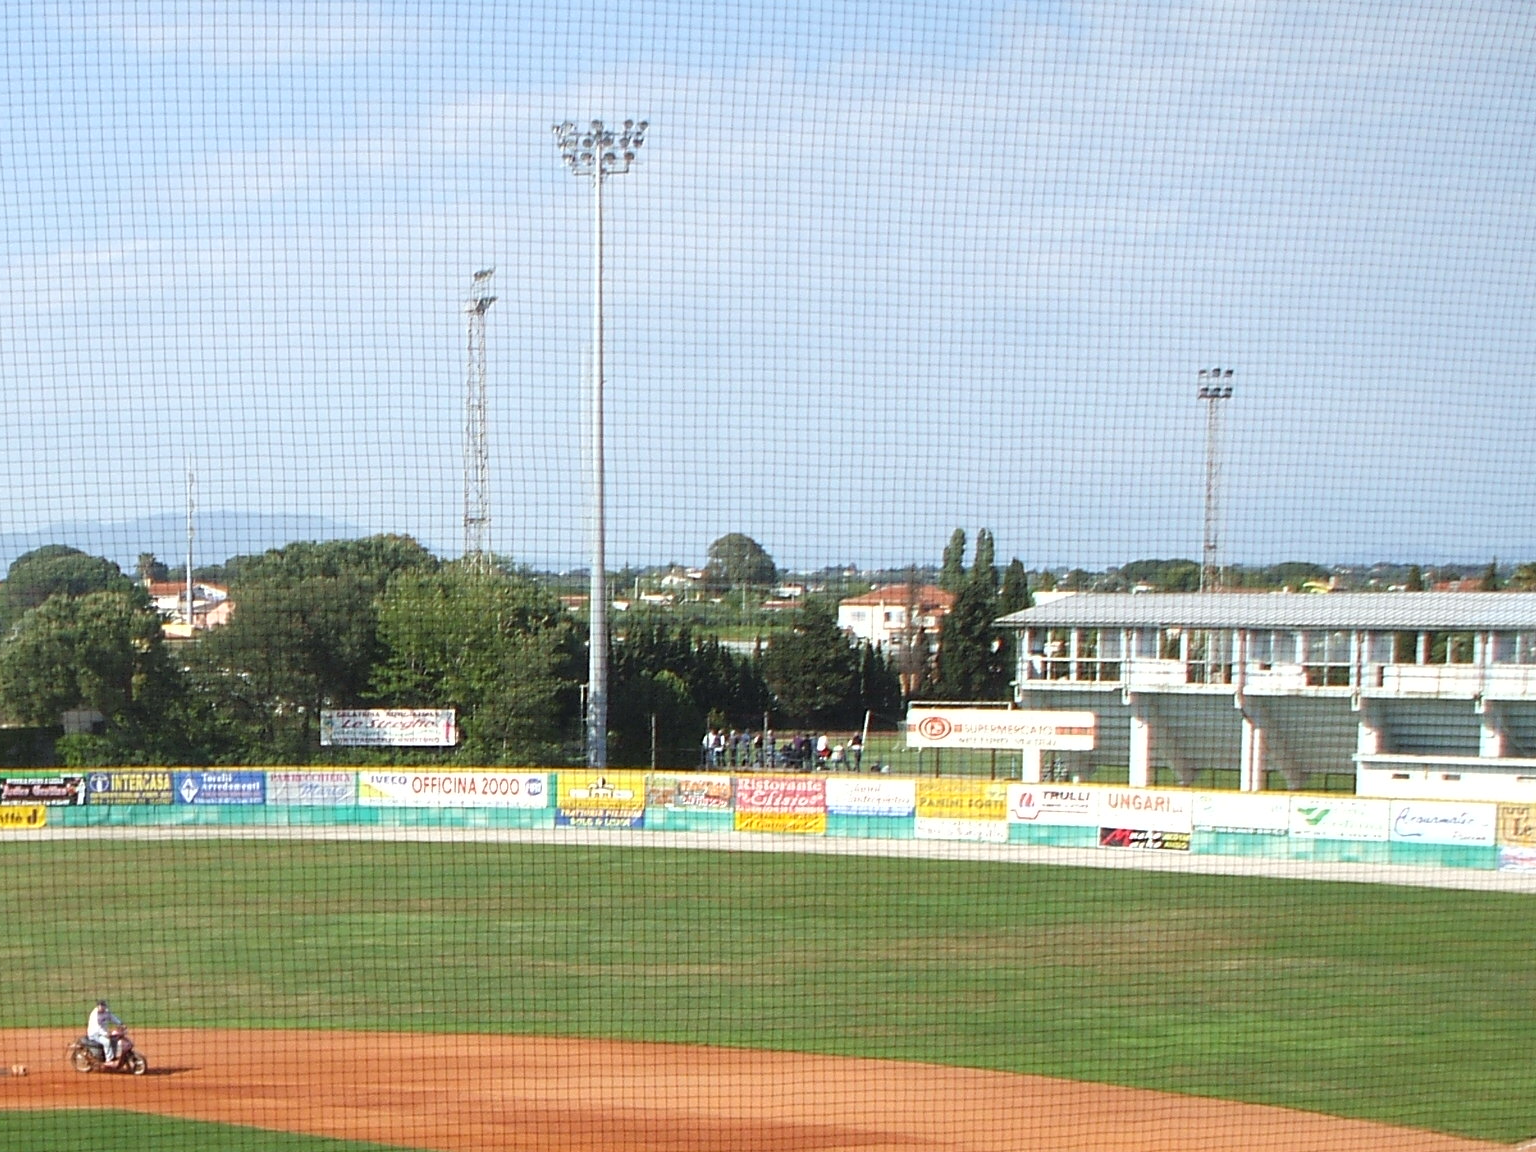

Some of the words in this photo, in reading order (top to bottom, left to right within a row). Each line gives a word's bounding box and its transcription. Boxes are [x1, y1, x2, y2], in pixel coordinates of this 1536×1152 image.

[111, 774, 170, 791] INTERCASA
[371, 775, 407, 785] IVECO
[412, 776, 477, 795] OFFICINA
[482, 777, 519, 796] 2000
[737, 778, 822, 793] Ristorante
[1042, 791, 1090, 802] TRULLI
[1108, 793, 1171, 813] UNGARI
